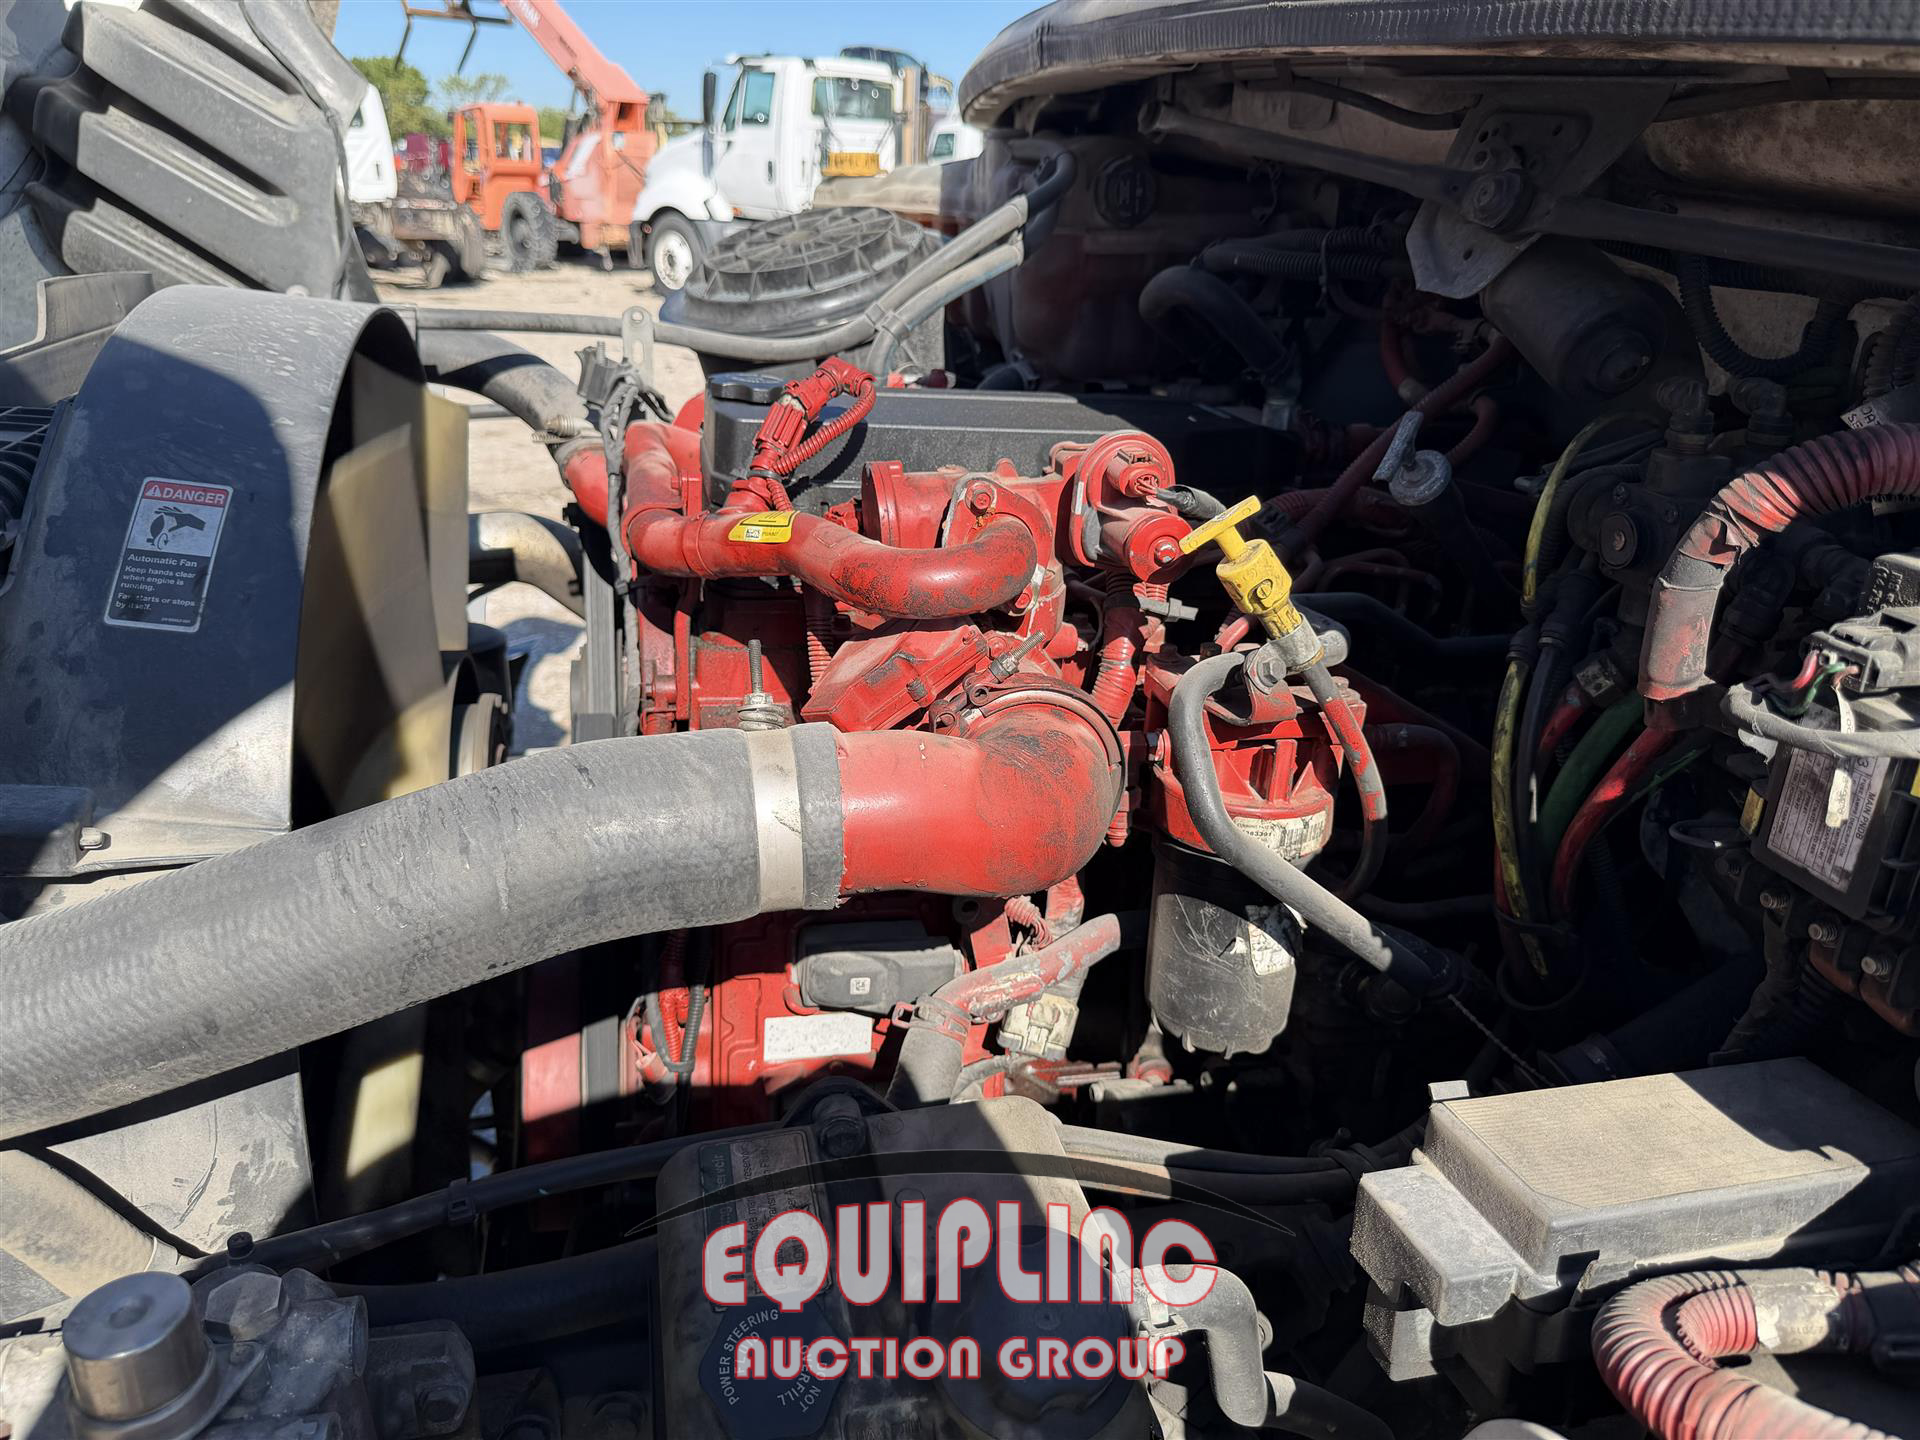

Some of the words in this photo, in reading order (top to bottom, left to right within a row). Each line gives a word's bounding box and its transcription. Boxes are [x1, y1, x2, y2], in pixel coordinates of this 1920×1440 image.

[162, 487, 225, 505] DANGER
[127, 553, 178, 566] Automatic
[179, 558, 197, 568] Fan
[125, 565, 147, 575] Keep
[148, 567, 173, 577] hands
[175, 570, 196, 578] clear
[120, 582, 156, 592] running.
[122, 573, 146, 582] when
[146, 576, 175, 586] engine
[176, 578, 184, 586] is
[115, 600, 126, 609] by
[172, 598, 195, 607] stops
[1862, 791, 1876, 815] MAIN
[723, 1309, 779, 1352] STEERING
[719, 1357, 740, 1406] POWER
[799, 1384, 822, 1414] NOT
